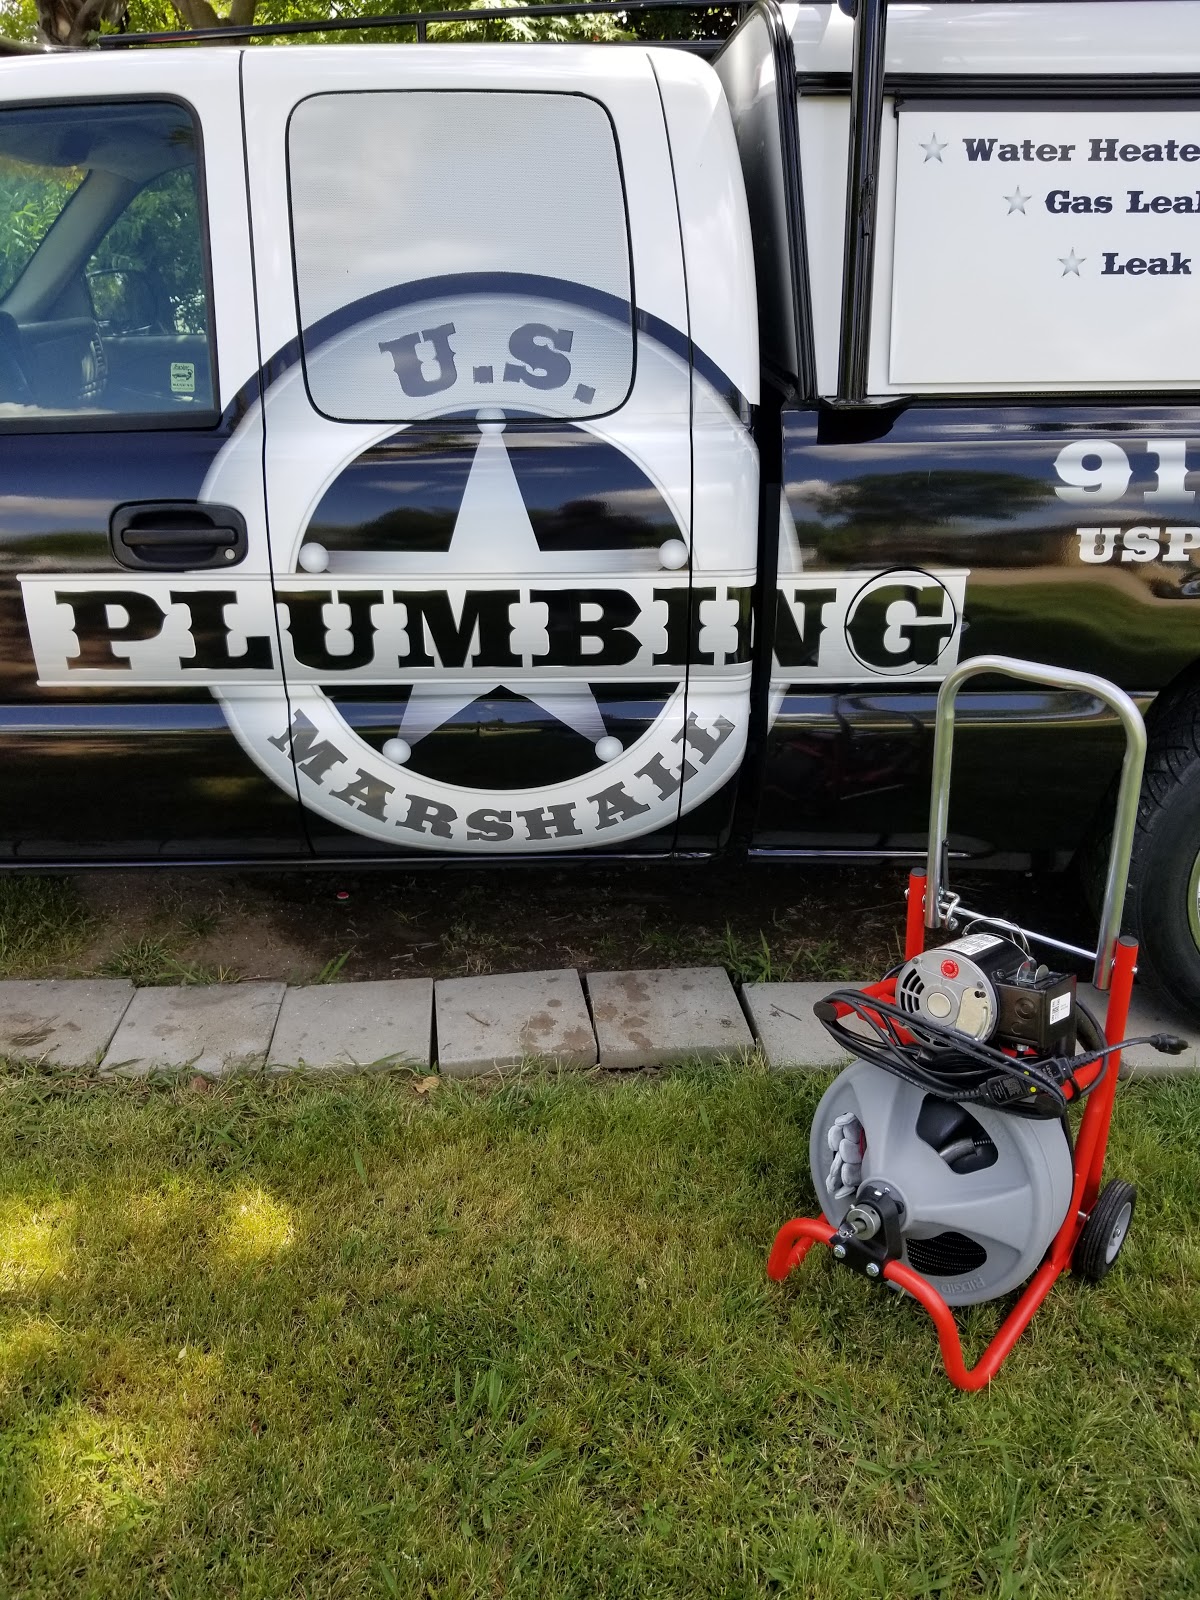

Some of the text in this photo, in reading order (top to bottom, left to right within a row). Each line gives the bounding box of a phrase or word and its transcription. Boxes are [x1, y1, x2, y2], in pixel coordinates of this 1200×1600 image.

[962, 138, 1200, 162] Water Heate
[1044, 189, 1200, 214] Gas Lea
[1100, 252, 1192, 275] Leak
[378, 322, 596, 405] U.S.
[1053, 439, 1196, 504] 91
[1075, 526, 1200, 563] USP
[54, 586, 953, 670] PLUMBING
[266, 708, 736, 842] MARSHALL
